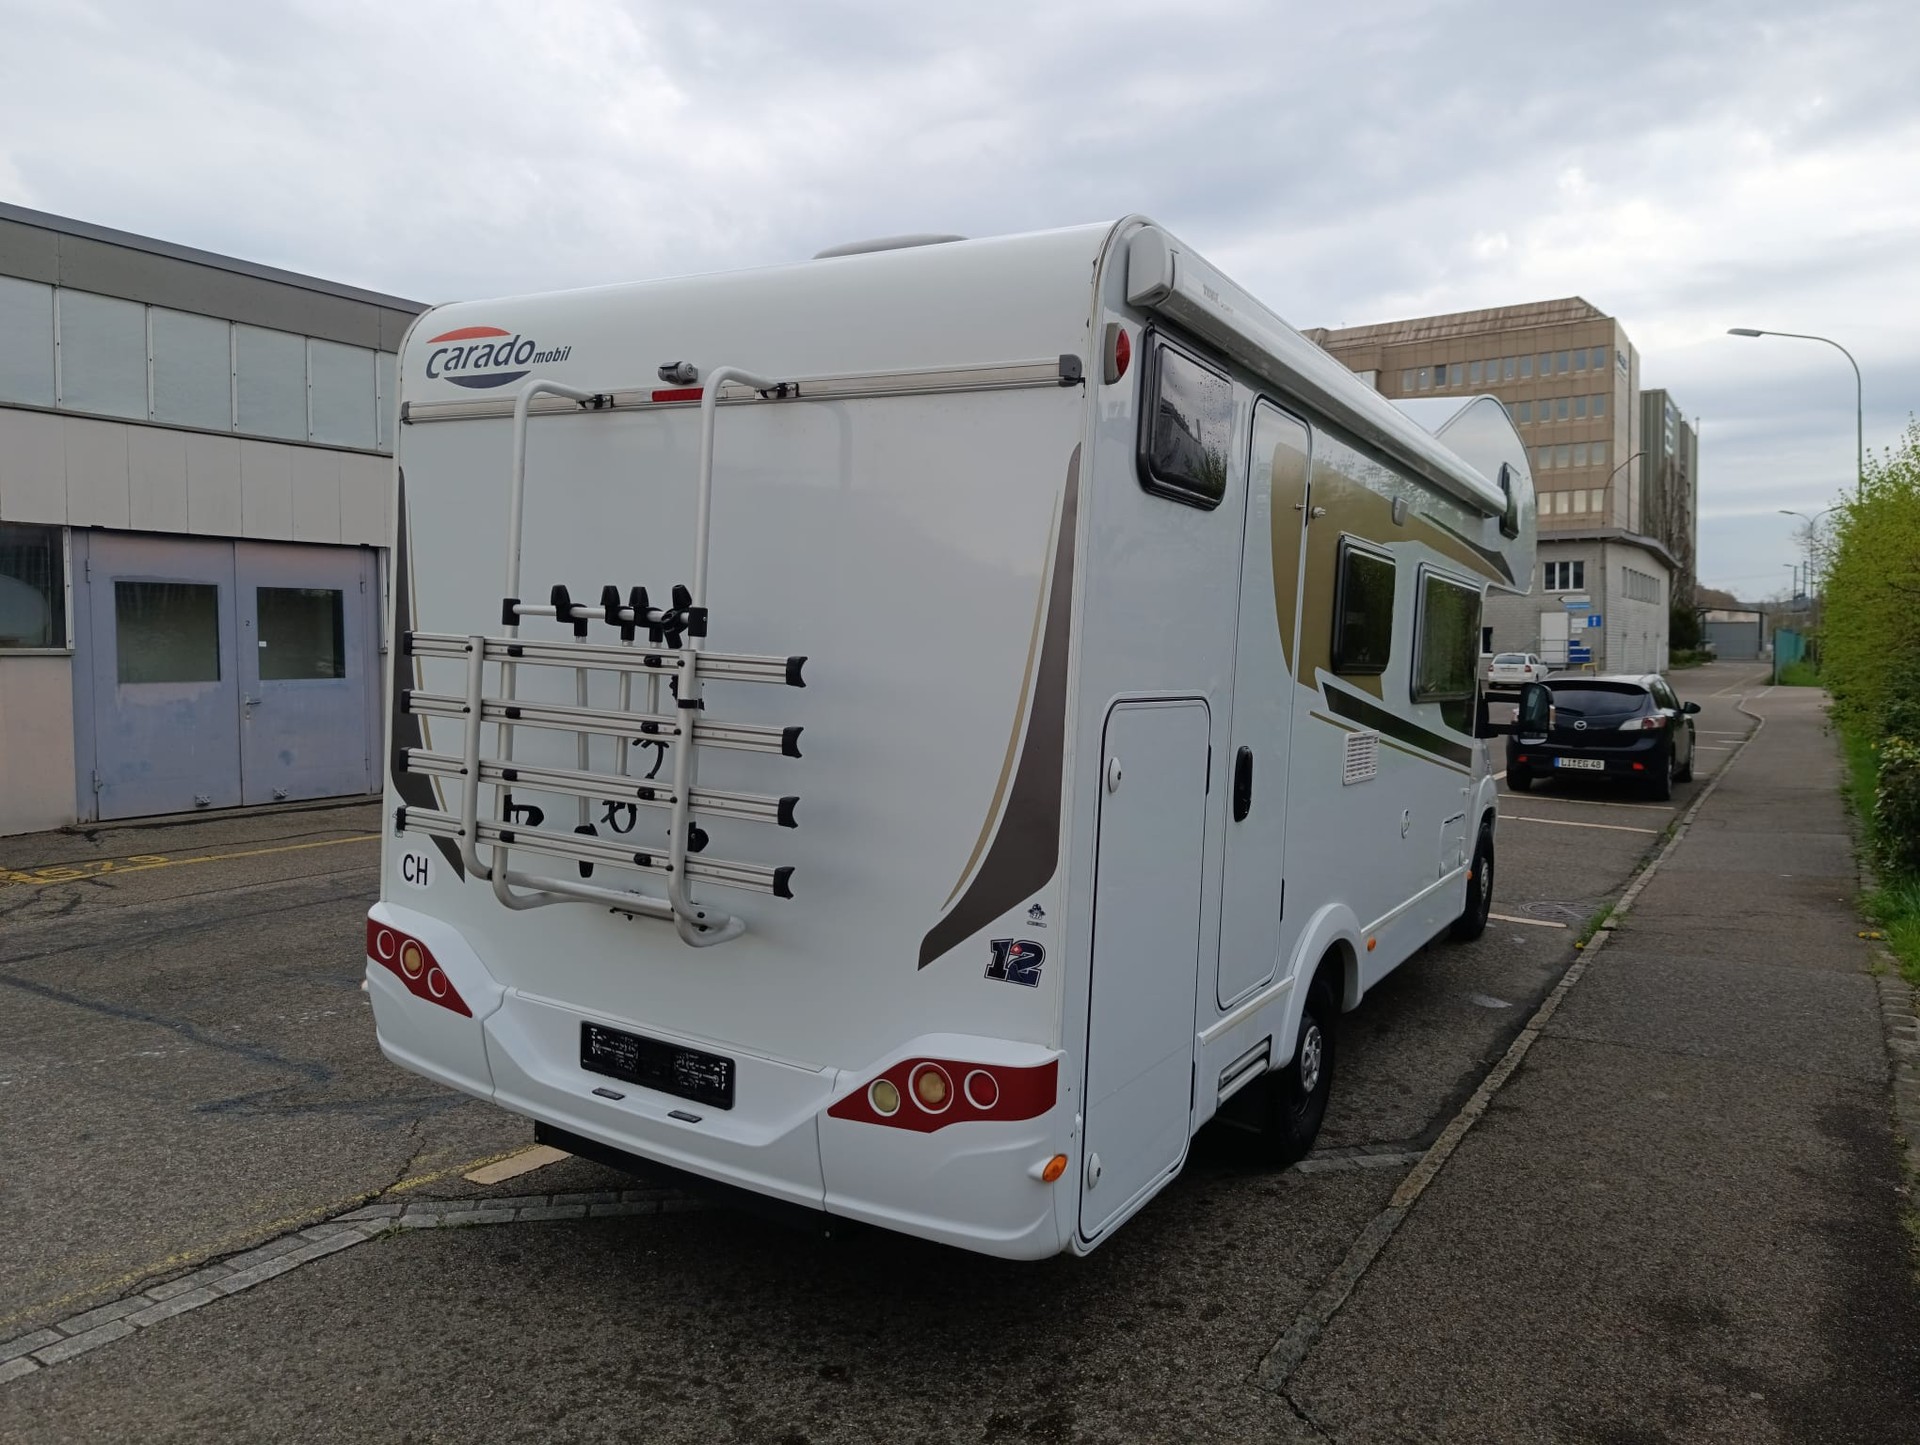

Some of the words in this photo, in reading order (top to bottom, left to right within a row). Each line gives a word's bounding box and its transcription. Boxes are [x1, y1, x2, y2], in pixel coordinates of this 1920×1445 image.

[425, 334, 536, 379] carado
[532, 346, 572, 364] mobil
[403, 853, 428, 886] CH
[984, 938, 1046, 988] 12
